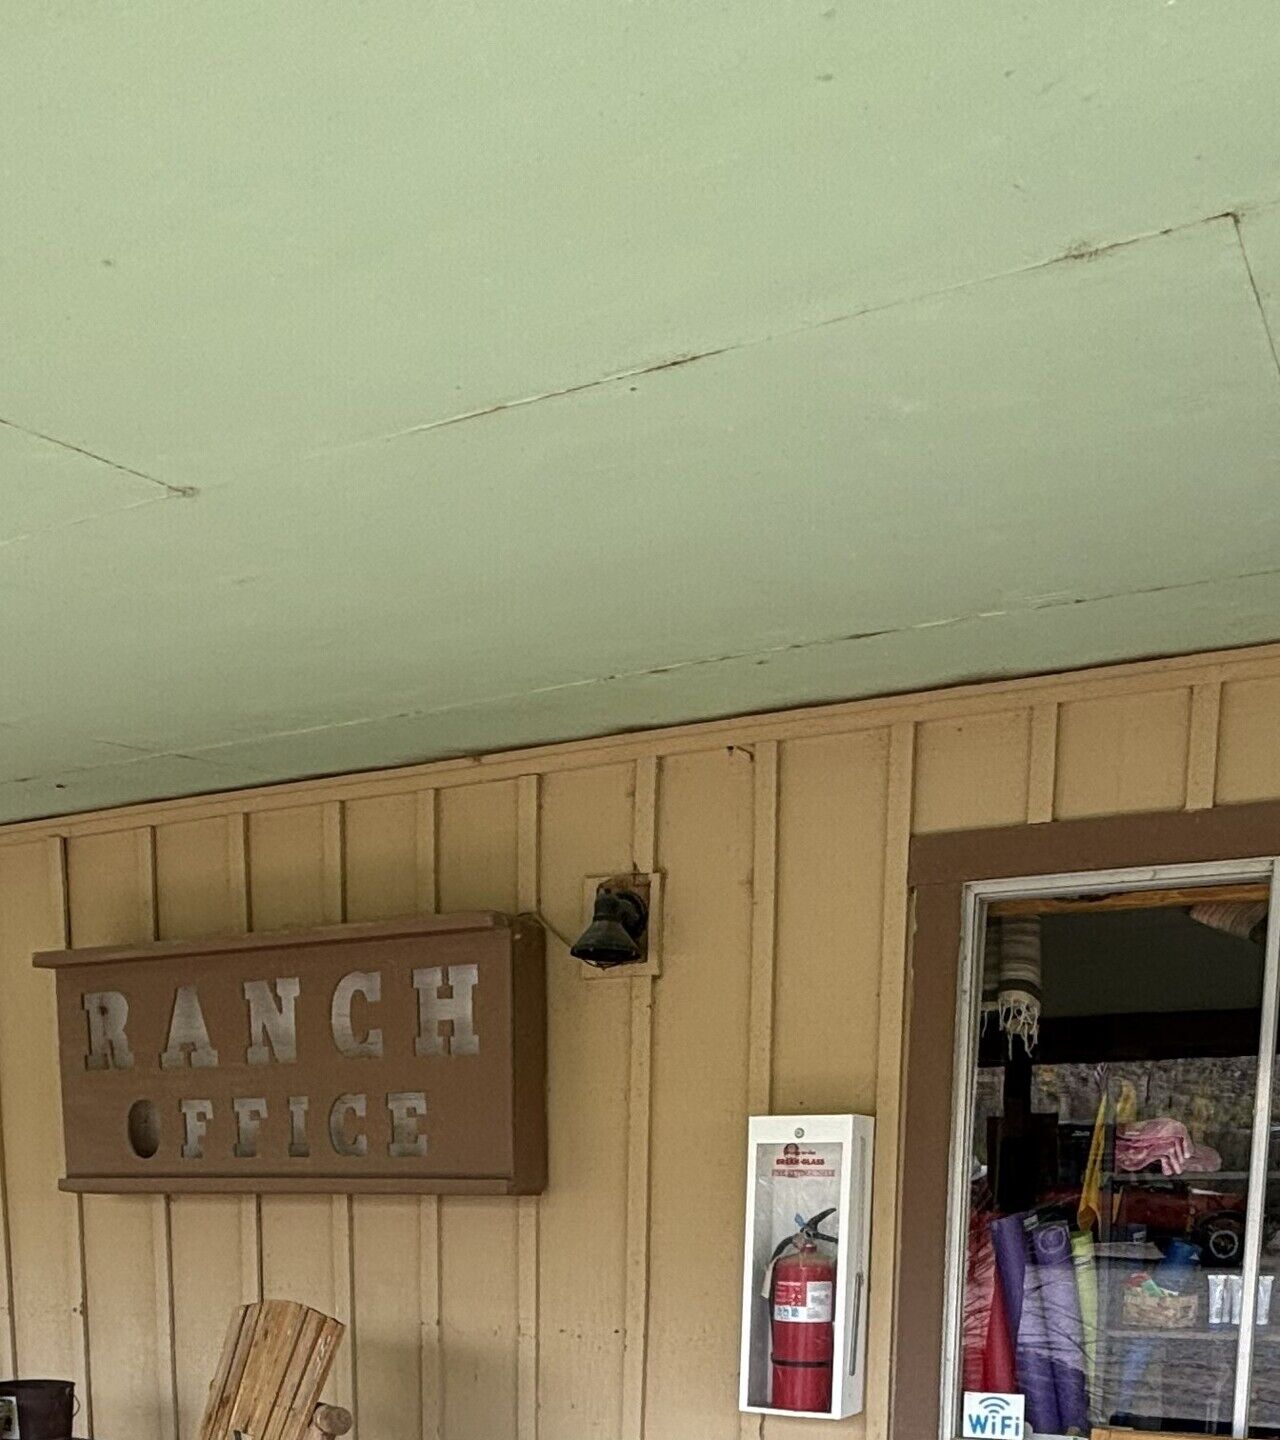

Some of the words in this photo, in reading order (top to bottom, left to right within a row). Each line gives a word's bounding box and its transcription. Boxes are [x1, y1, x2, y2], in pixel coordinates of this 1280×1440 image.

[82, 964, 480, 1071] RANCH
[127, 1092, 428, 1159] OFFICE
[968, 1413, 1020, 1437] WiFi
